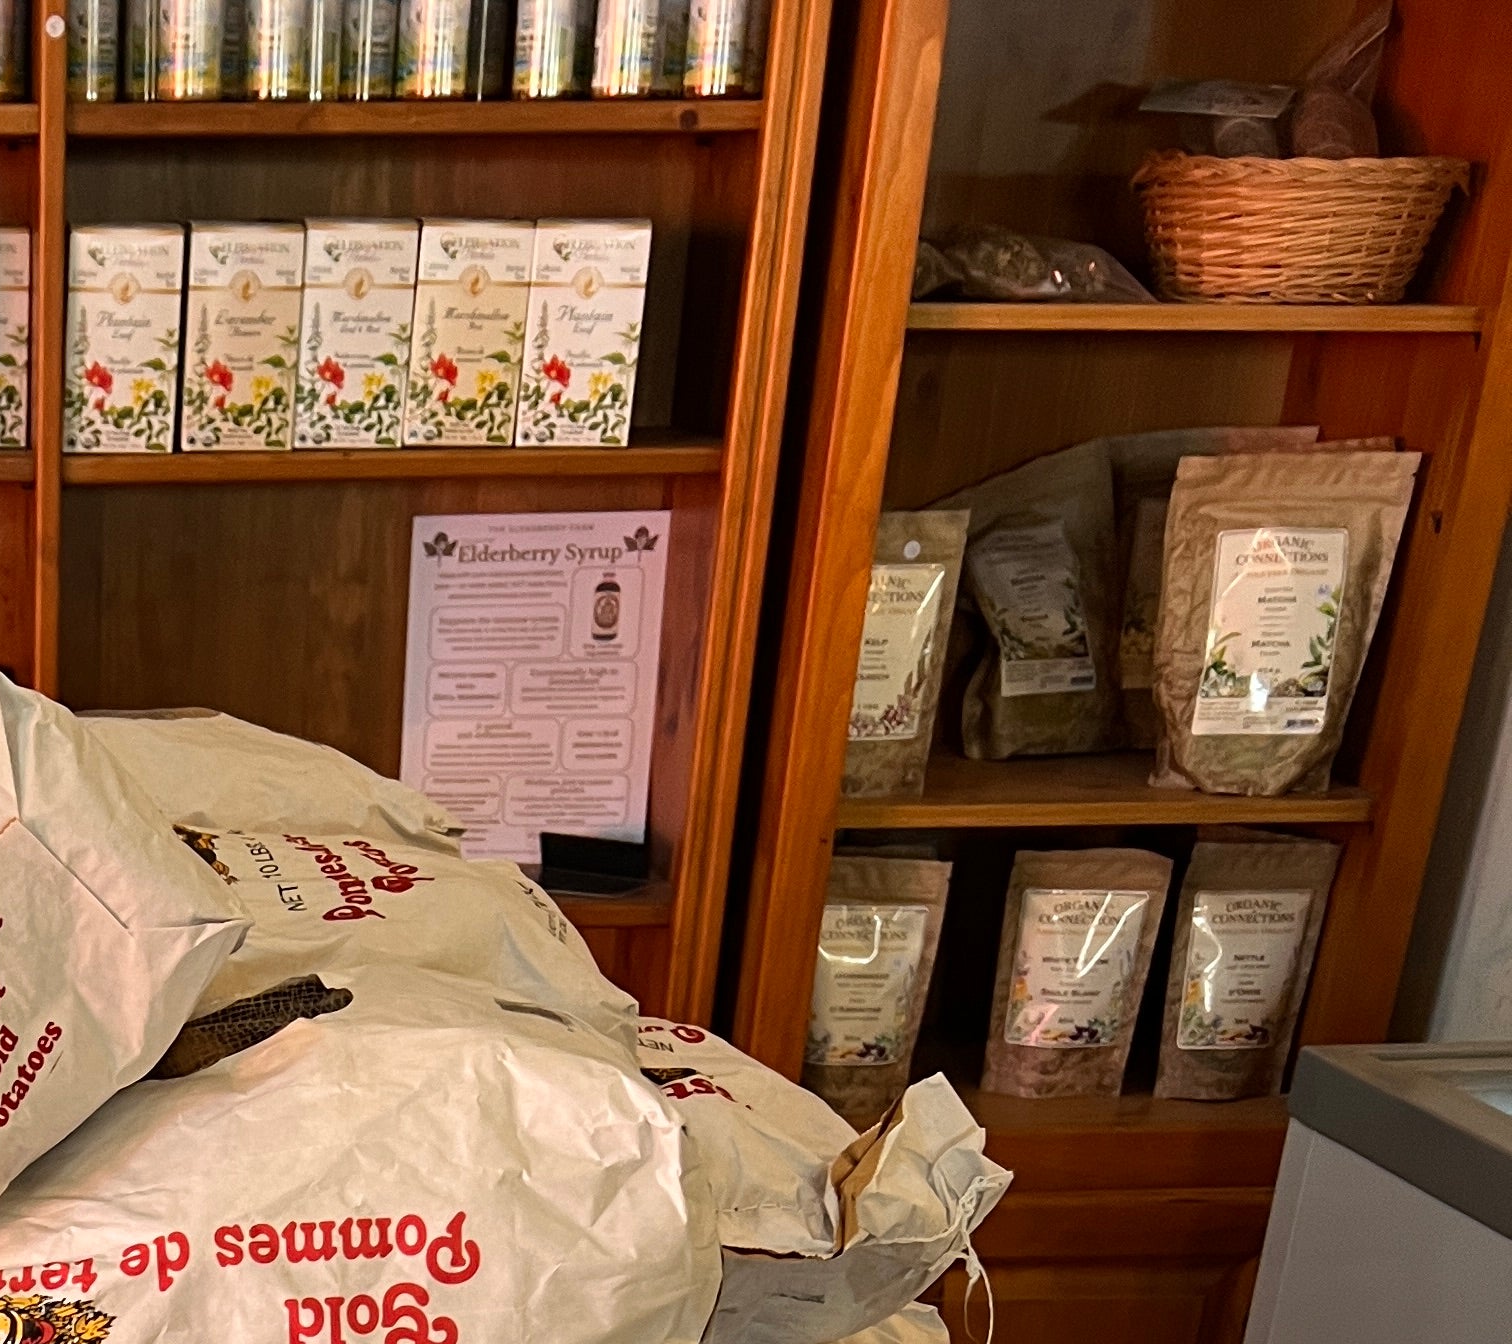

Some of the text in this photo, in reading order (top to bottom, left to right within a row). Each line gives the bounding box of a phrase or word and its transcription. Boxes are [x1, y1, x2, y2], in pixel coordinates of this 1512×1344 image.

[458, 543, 624, 565] Elderberry Syrup
[277, 882, 308, 912] NET
[119, 1230, 190, 1292] de
[214, 1210, 481, 1285] Pommes
